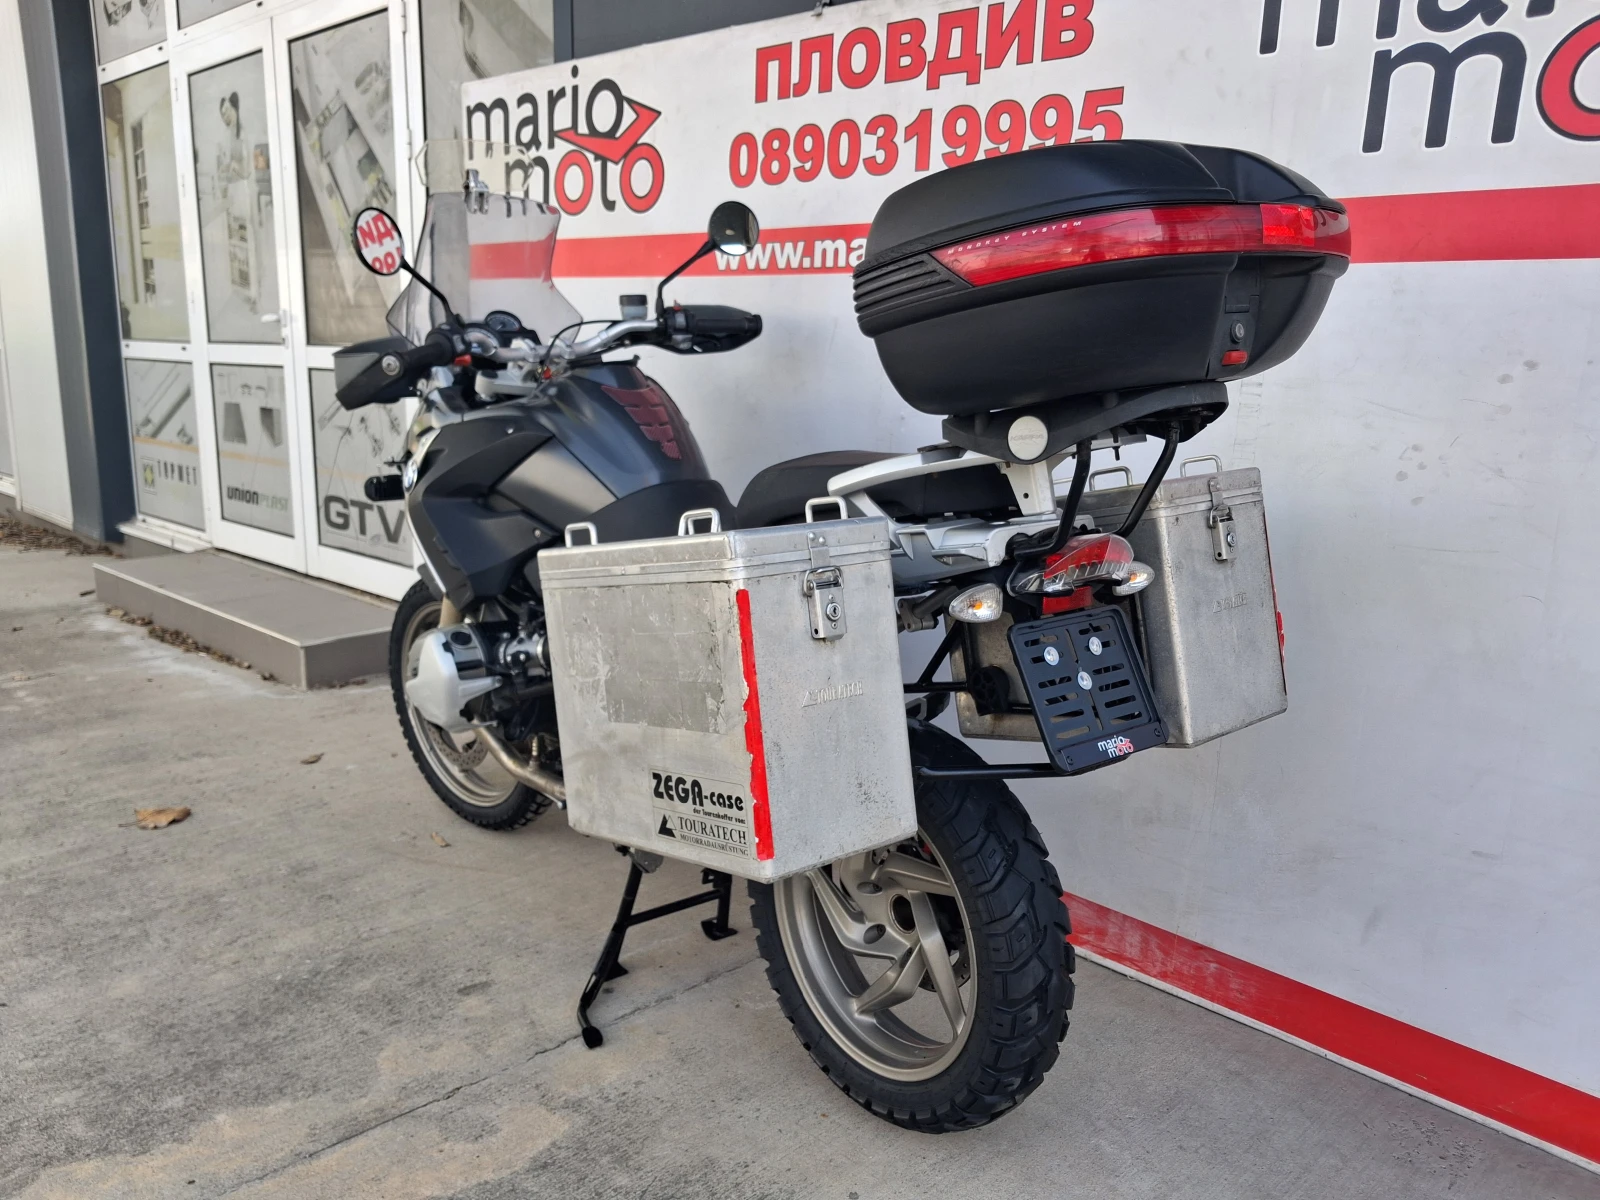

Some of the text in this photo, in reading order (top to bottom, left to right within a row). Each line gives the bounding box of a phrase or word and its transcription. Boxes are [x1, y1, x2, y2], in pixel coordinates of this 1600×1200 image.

[755, 0, 1095, 104] ПЛОВДИВ
[466, 64, 624, 160] mario
[728, 86, 1125, 189] 0890319995
[505, 142, 665, 218] moto
[947, 220, 1082, 255] MONOKEY SYSTEM
[157, 459, 197, 487] TOPMET
[324, 495, 406, 545] GTV
[1097, 734, 1126, 752] mario
[1107, 742, 1134, 758] moto
[651, 771, 744, 812] ZEGA-case
[693, 807, 701, 815] der
[677, 816, 748, 846] TOURATECH
